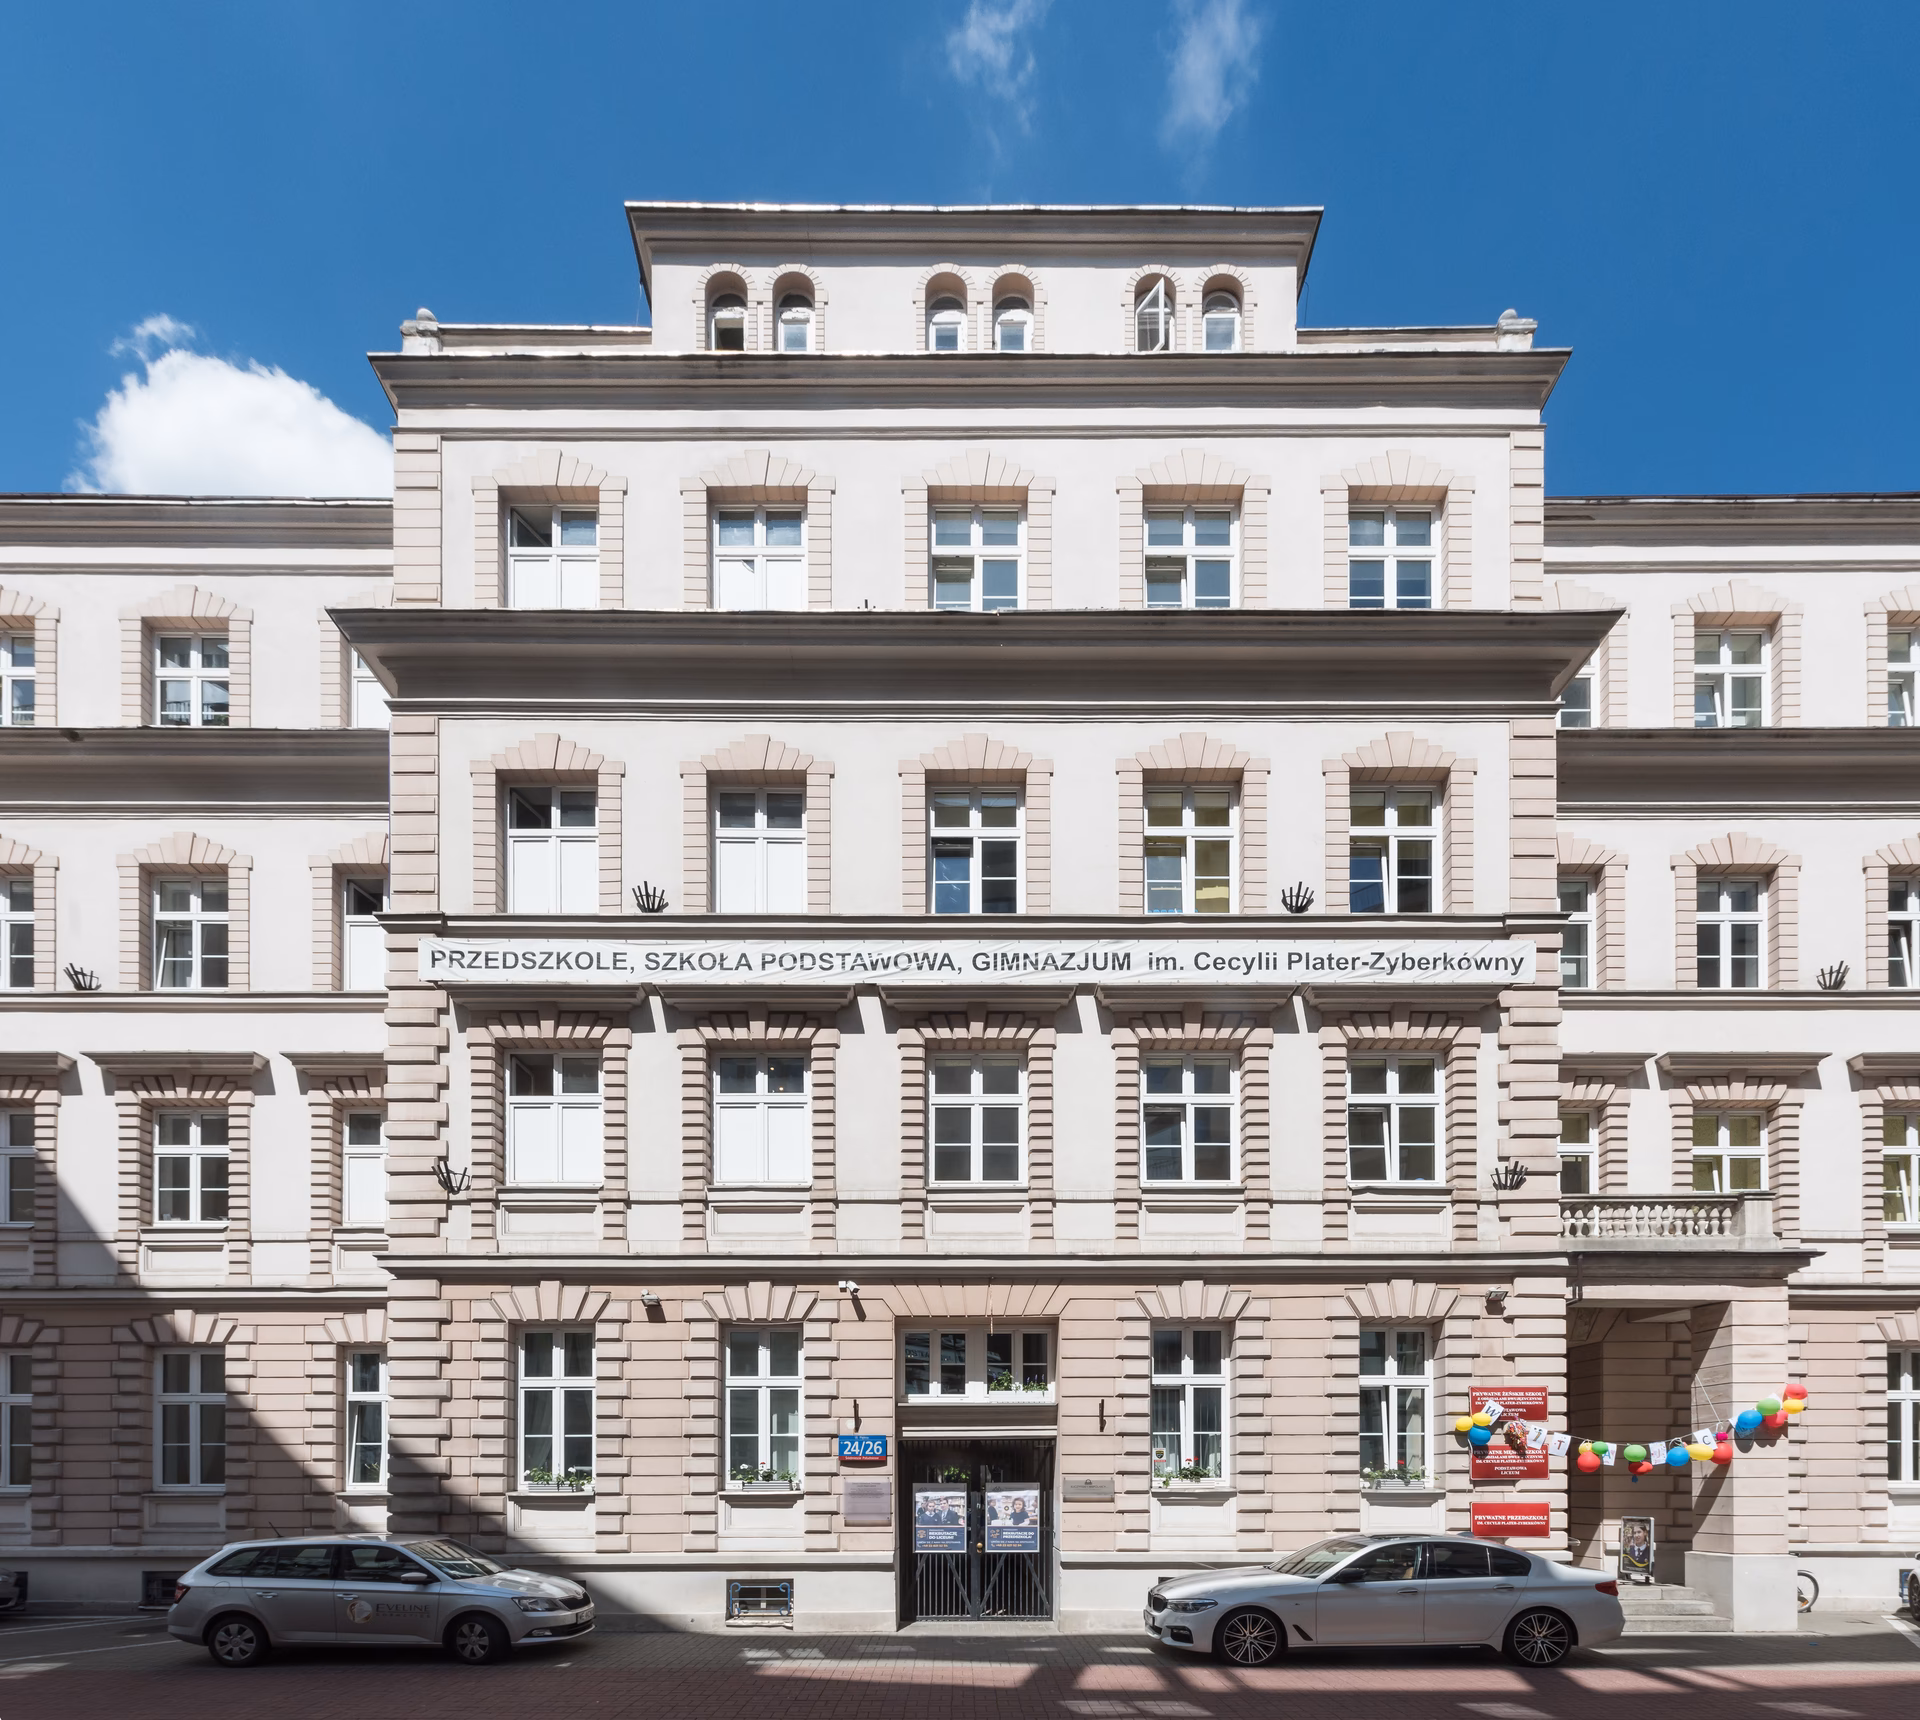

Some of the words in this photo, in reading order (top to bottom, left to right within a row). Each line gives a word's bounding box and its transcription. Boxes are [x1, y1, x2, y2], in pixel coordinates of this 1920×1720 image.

[430, 950, 635, 974] PRZEDSZKOLE,
[644, 952, 753, 971] SZKOŁA
[761, 952, 962, 974] PODSTAWOWA,
[972, 952, 1131, 971] GIMNAZJUM
[1148, 952, 1185, 971] im.
[1193, 951, 1278, 976] Cecylii
[1287, 951, 1525, 976] Plater-Zyberkówny
[1485, 1406, 1500, 1417] W
[1702, 1435, 1711, 1445] C
[843, 1441, 883, 1456] 24/26
[376, 1603, 431, 1612] EVELINE
